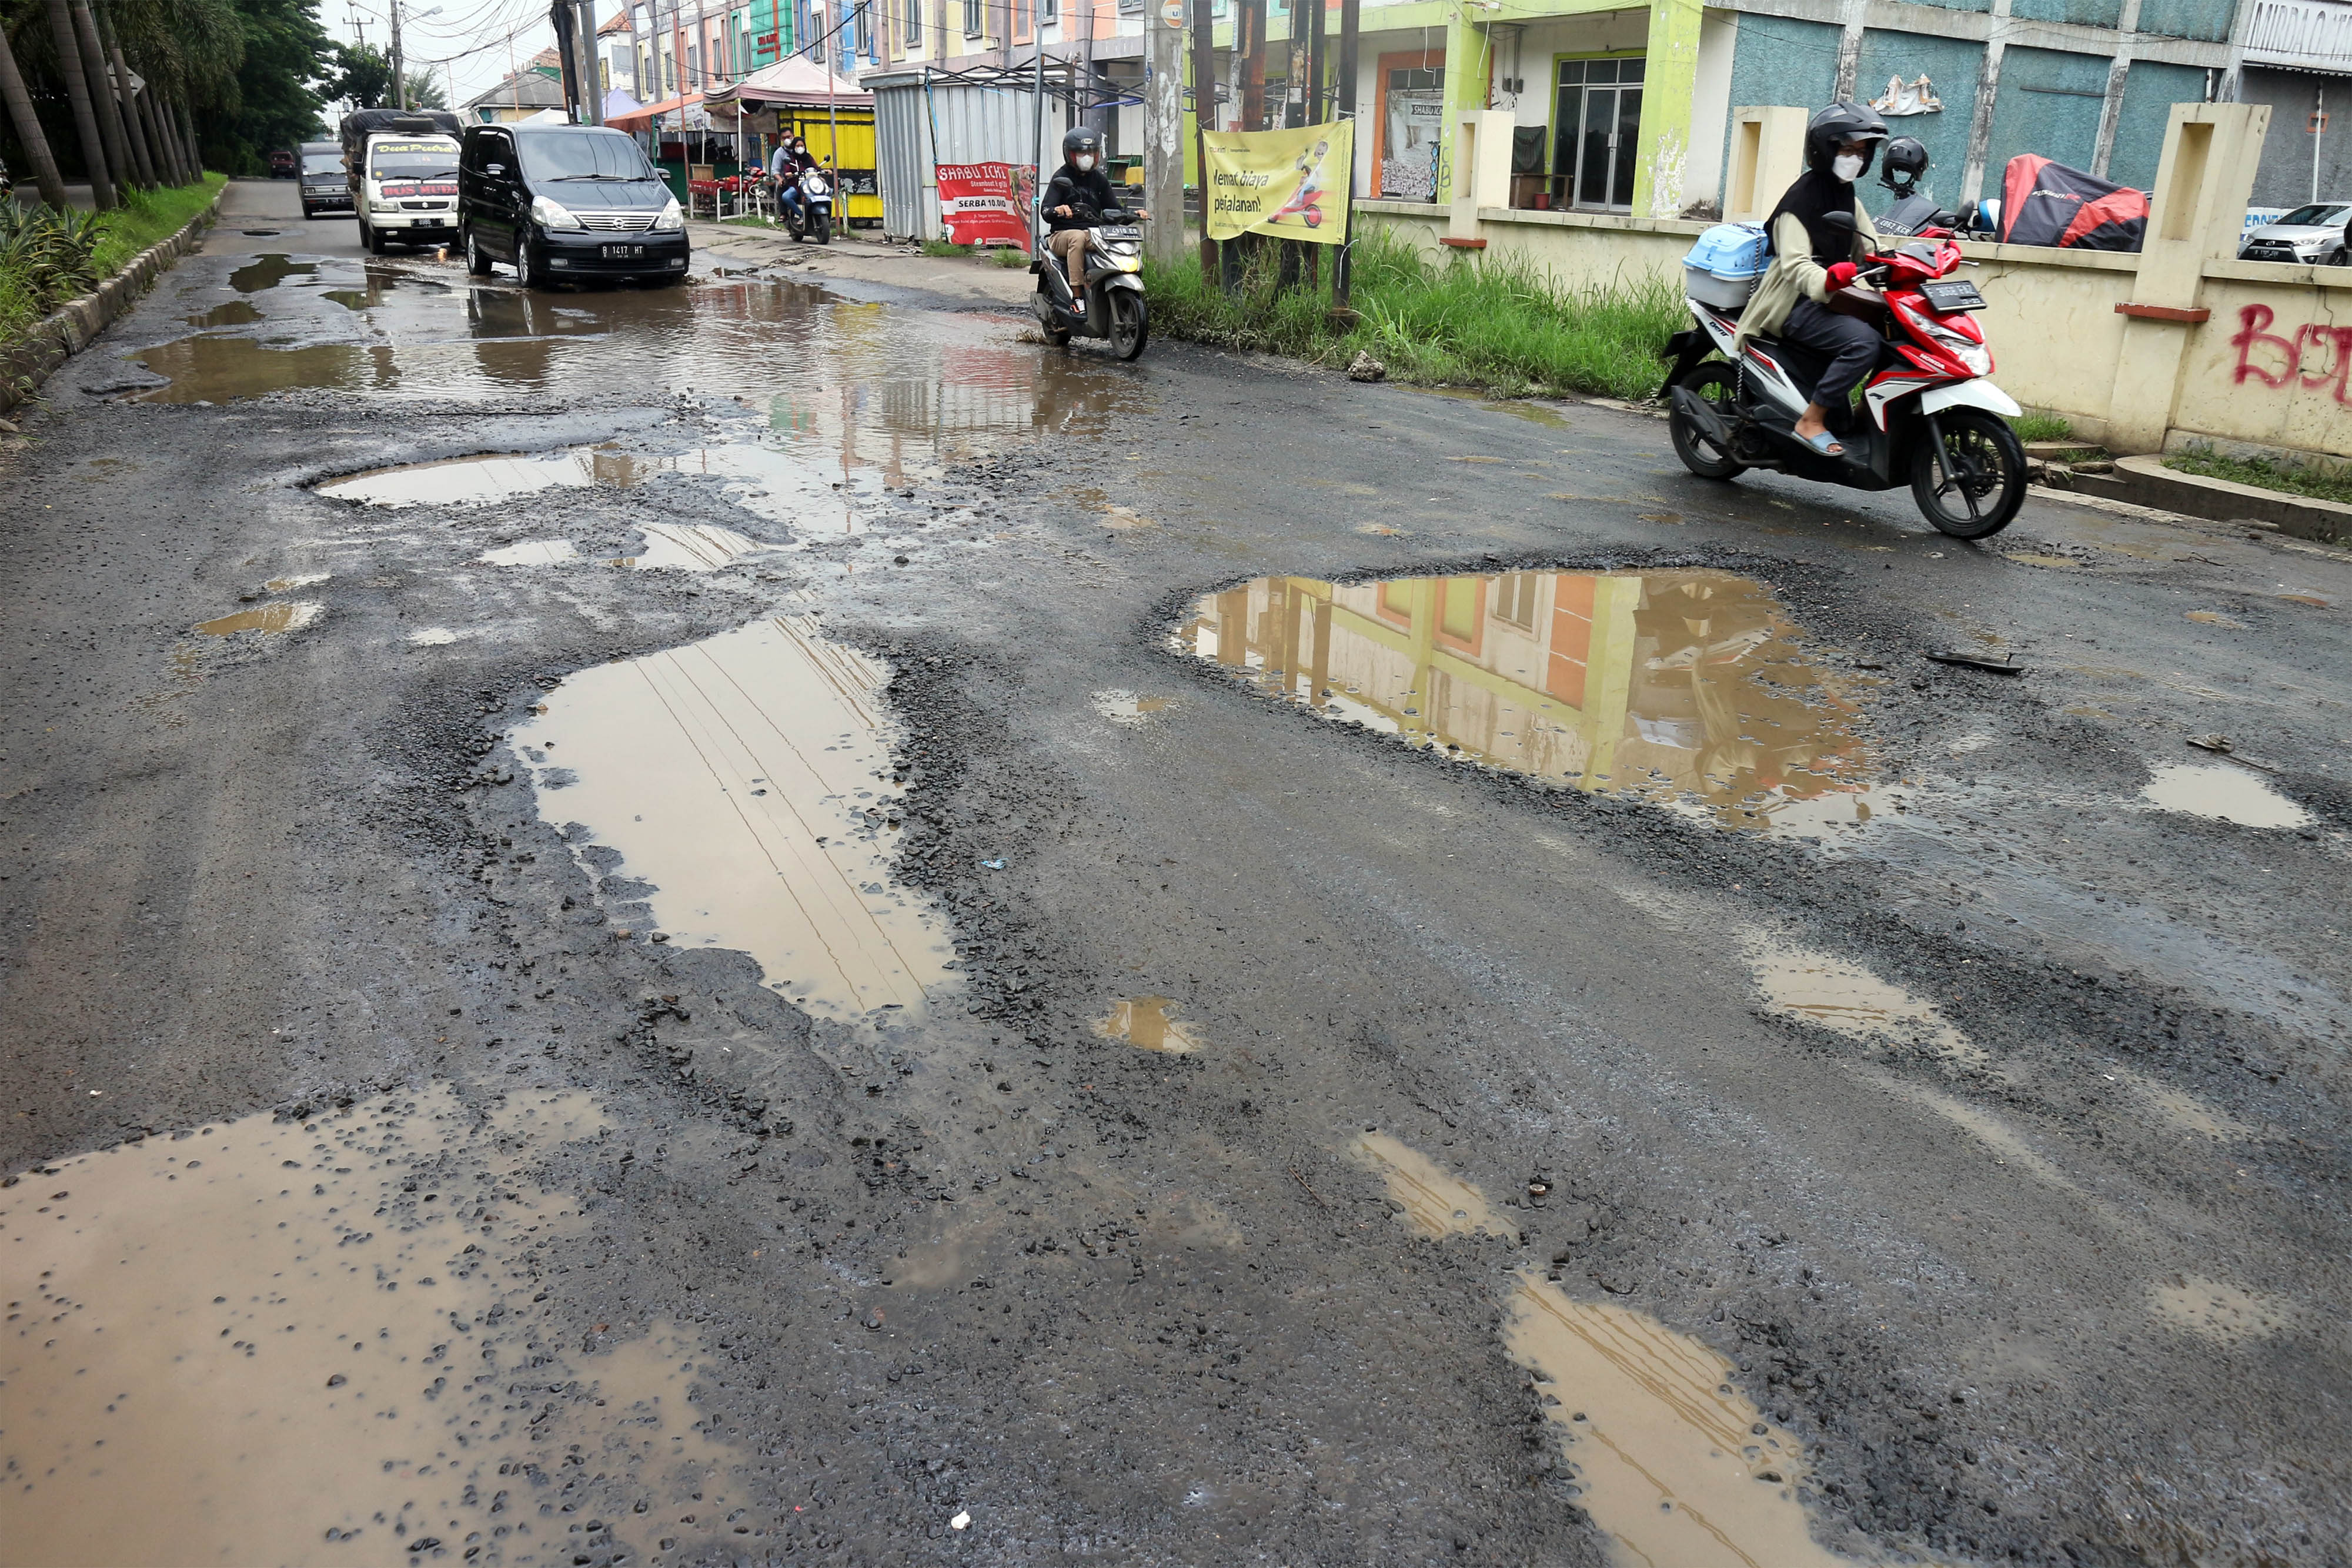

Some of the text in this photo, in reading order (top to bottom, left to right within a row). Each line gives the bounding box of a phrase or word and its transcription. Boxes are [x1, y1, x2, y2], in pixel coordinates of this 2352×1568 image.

[1414, 106, 1442, 115] SHABU ICH
[377, 144, 452, 153] Dua Putra
[939, 165, 1007, 180] SHABU ICHI
[1240, 170, 1269, 190] biaya
[1215, 195, 1261, 214] pejalanan!
[1879, 220, 1896, 229] 4062
[603, 246, 643, 254] B 1417 HT
[1919, 353, 1945, 369] HONDA
